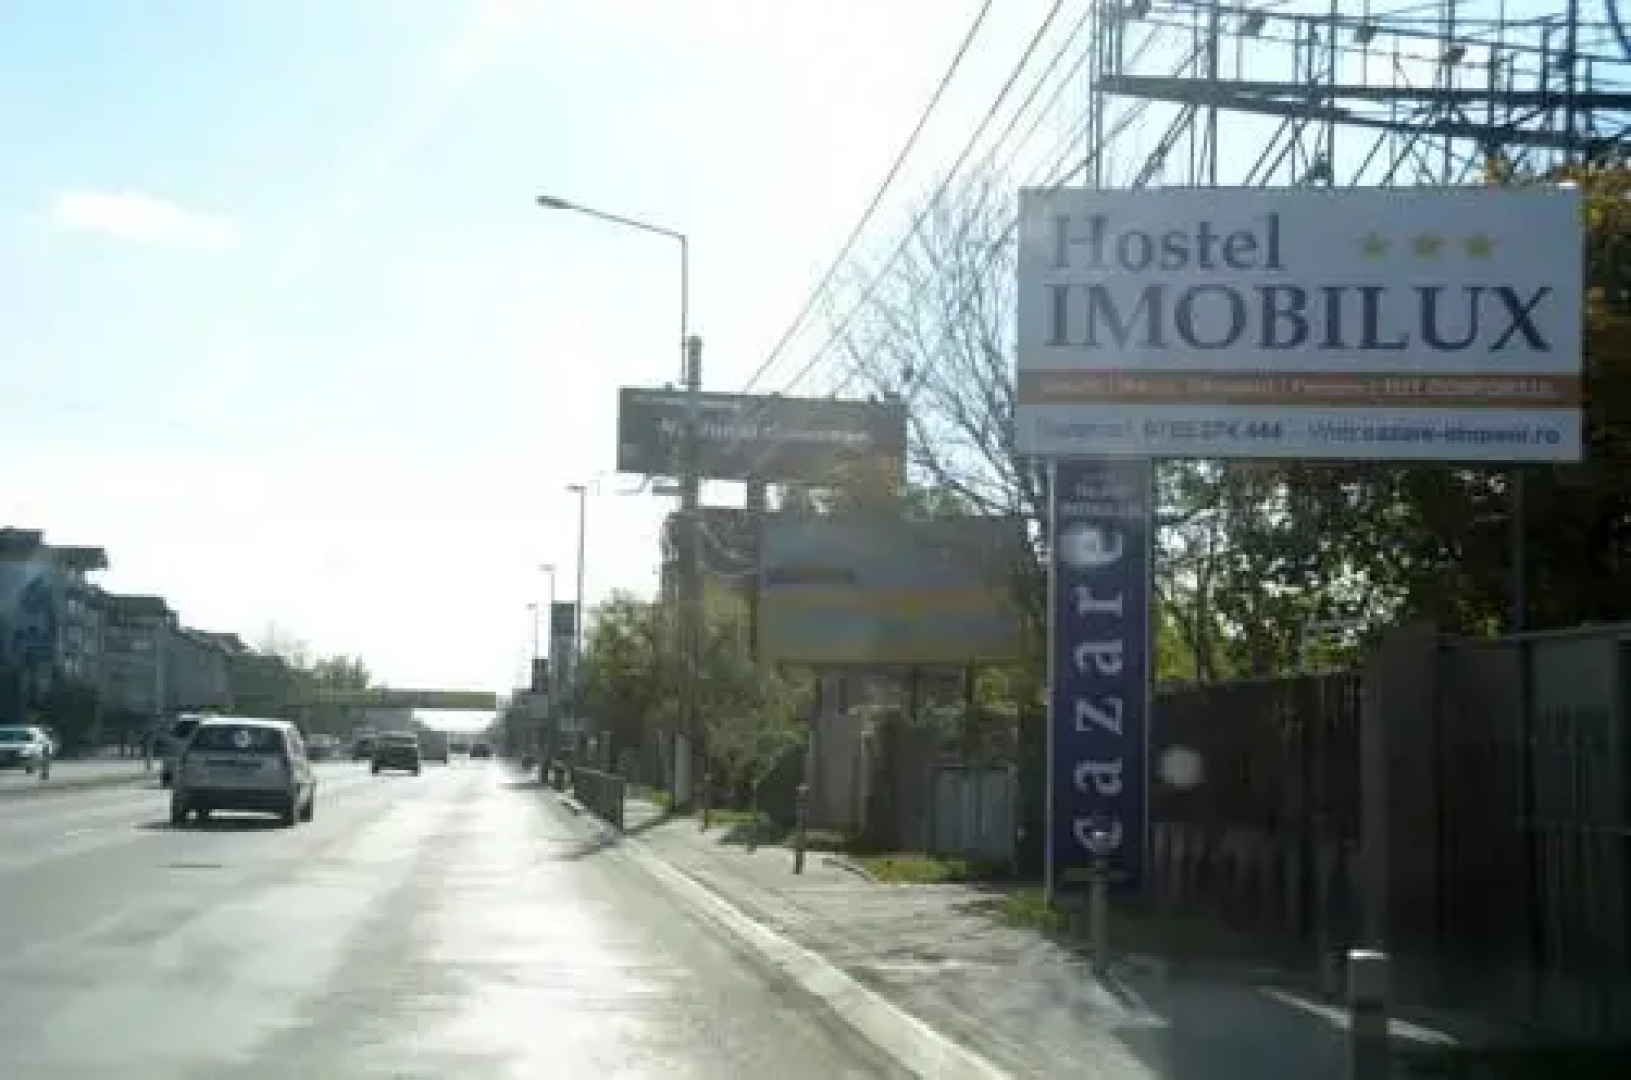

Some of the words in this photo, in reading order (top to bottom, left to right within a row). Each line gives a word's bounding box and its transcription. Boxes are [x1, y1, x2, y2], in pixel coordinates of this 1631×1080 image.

[1049, 212, 1286, 273] Hostel
[1043, 284, 1553, 353] IMOBILUX
[1072, 522, 1124, 854] cazare
